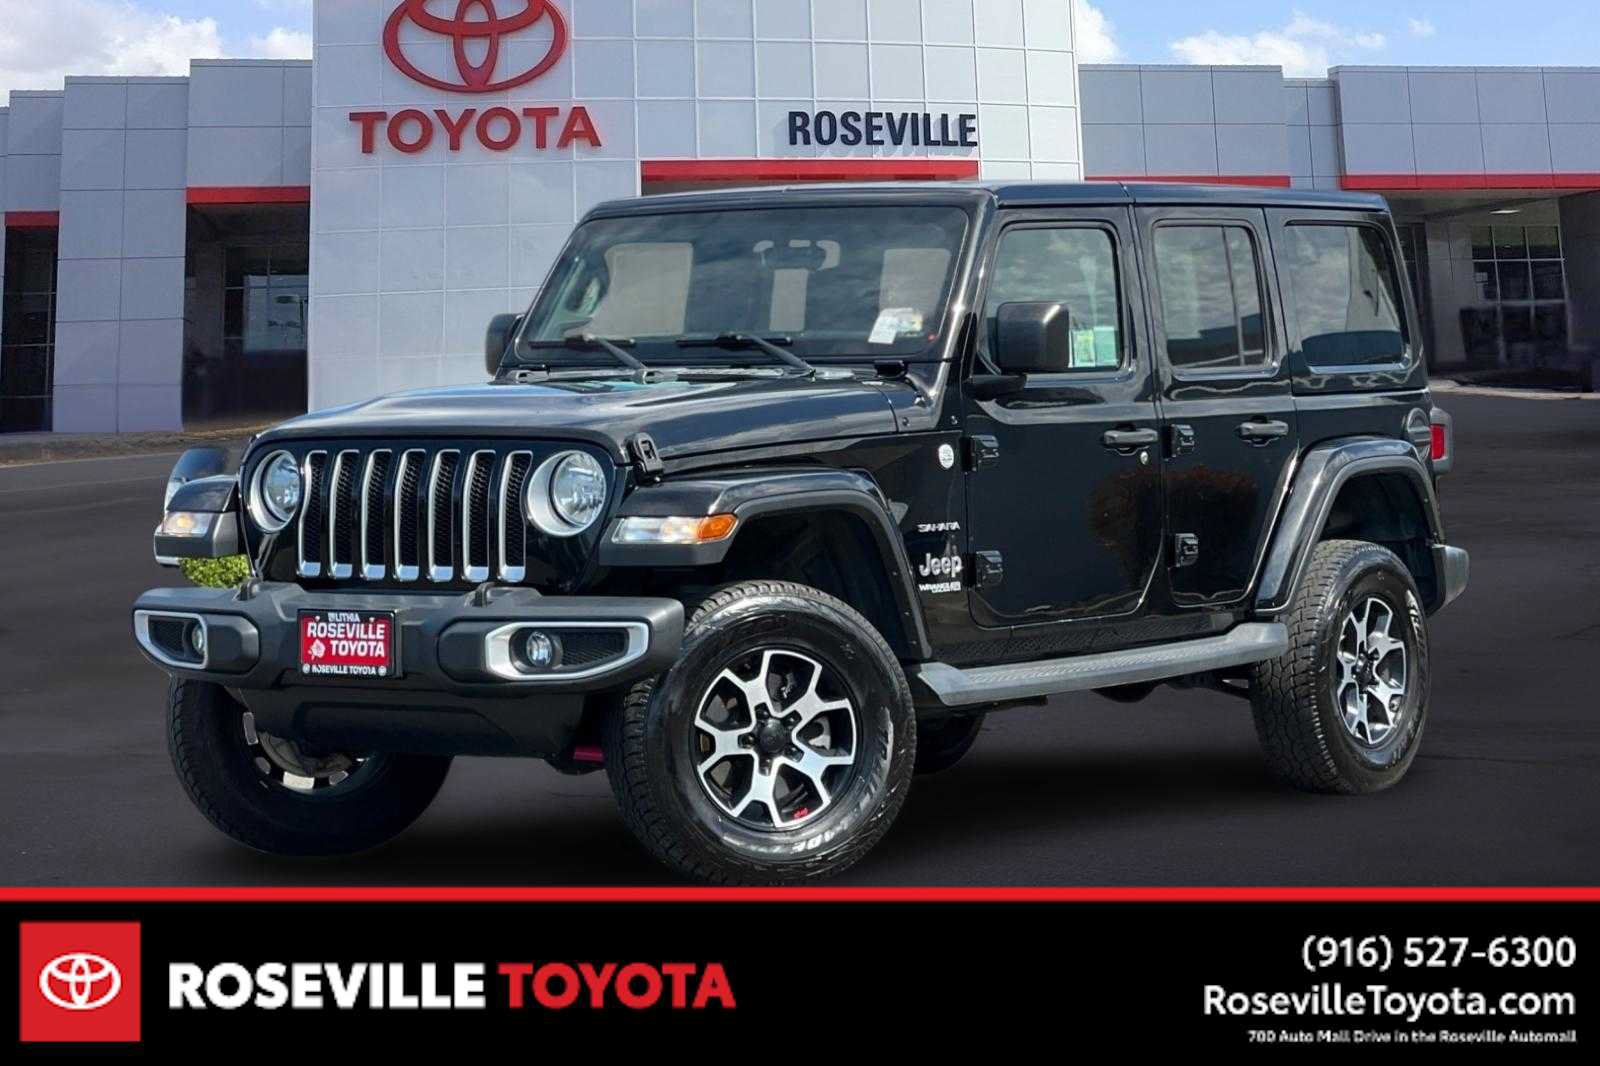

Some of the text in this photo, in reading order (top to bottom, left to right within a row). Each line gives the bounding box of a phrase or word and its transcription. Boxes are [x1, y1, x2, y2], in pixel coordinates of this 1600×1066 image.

[349, 106, 602, 154] TOYOTA
[788, 111, 978, 147] ROSEVILLE
[919, 552, 962, 578] Jeep
[307, 622, 386, 639] ROSEVILLE
[330, 640, 385, 657] TOYOTA
[312, 664, 376, 675] ROSEVILLE TOYOTA
